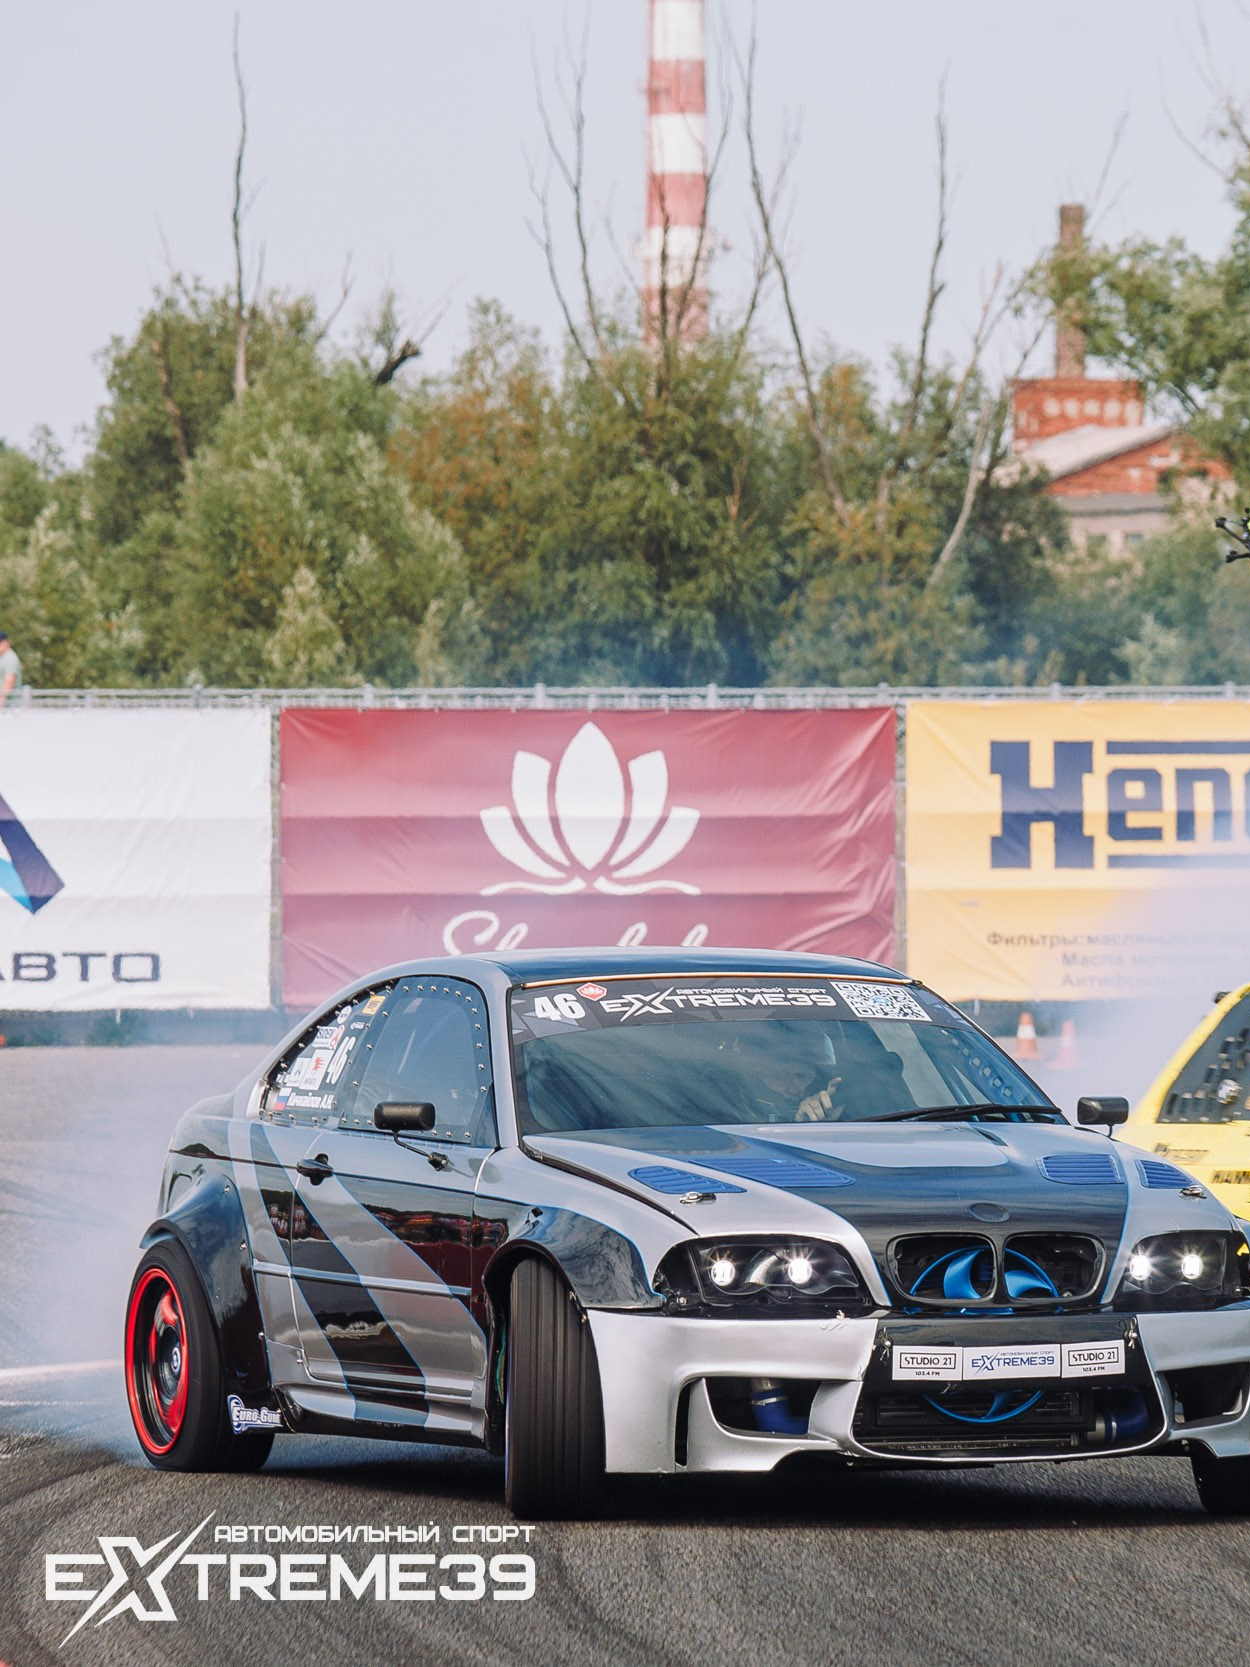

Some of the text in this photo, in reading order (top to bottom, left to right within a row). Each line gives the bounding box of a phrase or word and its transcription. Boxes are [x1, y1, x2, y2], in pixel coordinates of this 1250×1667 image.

[0, 952, 160, 982] ВТО
[675, 986, 827, 995] АВТОМОБИЛЬНЫЙ СПОРТ
[533, 993, 587, 1021] 46
[599, 986, 837, 1022] EXTREME39
[325, 1036, 356, 1085] 46
[904, 1357, 952, 1365] STUDIO 21
[971, 1351, 1055, 1375] EXTREME39
[1072, 1351, 1115, 1362] STUDIO 21
